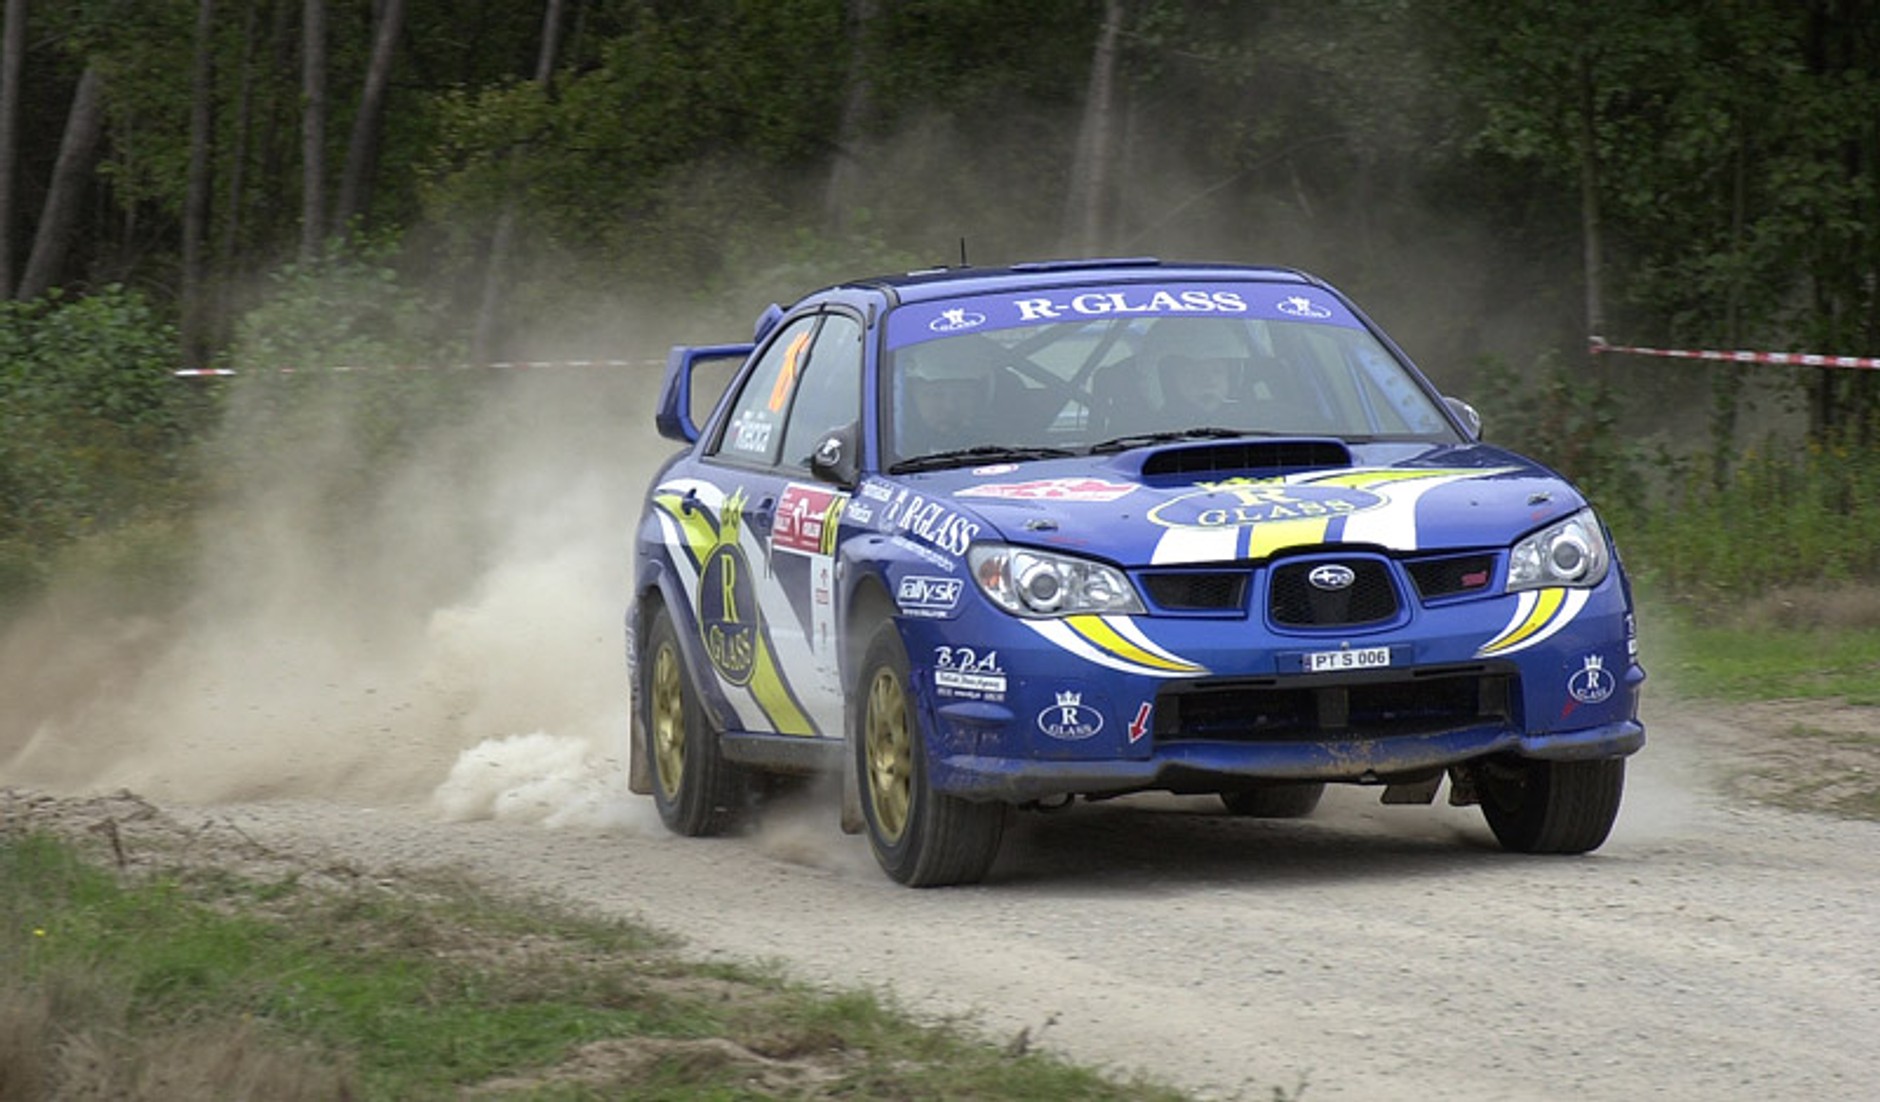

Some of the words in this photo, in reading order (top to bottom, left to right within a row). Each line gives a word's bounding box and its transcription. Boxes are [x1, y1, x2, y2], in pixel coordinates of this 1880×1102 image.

[1015, 290, 1247, 320] R-GLASS
[1237, 488, 1303, 506] R
[1198, 499, 1356, 526] GLASS
[721, 554, 740, 623] R
[710, 624, 751, 671] GLASS
[934, 645, 1003, 673] B.P.A.
[1315, 653, 1338, 668] PT
[1341, 653, 1353, 666] S
[1358, 651, 1386, 666] 006
[1587, 671, 1600, 689] R
[1061, 707, 1079, 725] R
[1047, 724, 1092, 736] GLASS
